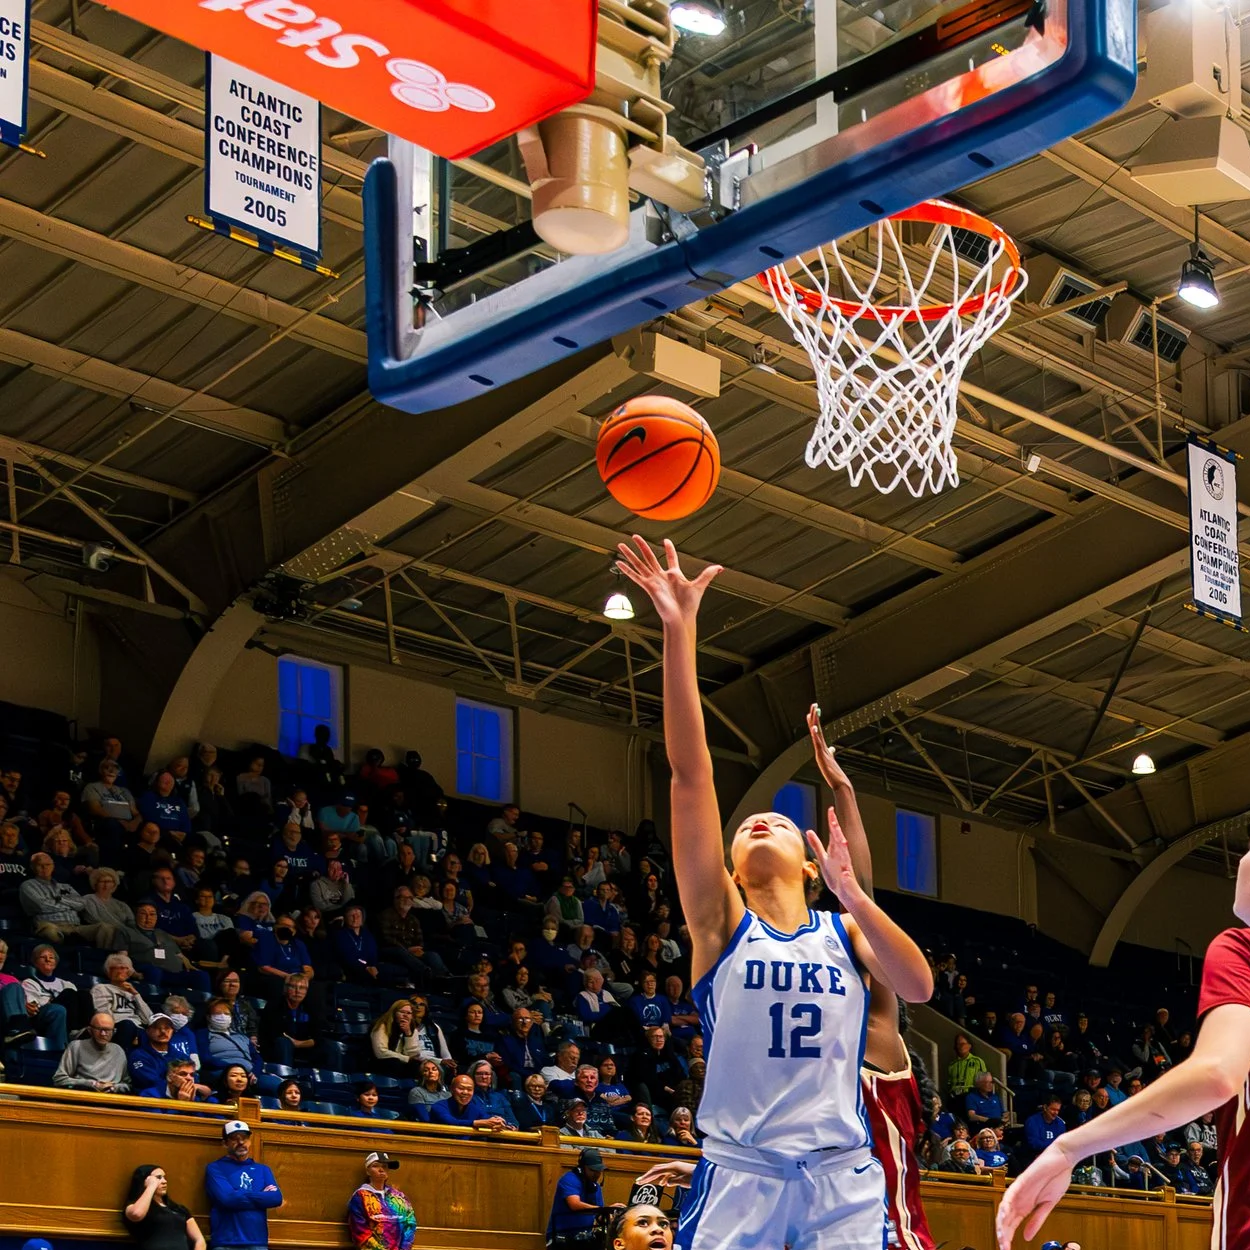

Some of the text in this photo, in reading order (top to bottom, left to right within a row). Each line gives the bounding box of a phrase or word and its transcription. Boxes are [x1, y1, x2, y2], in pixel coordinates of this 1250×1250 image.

[228, 79, 303, 123] ATLANTIC
[240, 105, 291, 139] COAST
[213, 115, 318, 172] CONFERENCE
[217, 139, 313, 191] CHAMPIONS
[234, 170, 297, 203] TOURNAMENT
[244, 195, 288, 227] 2005
[1199, 508, 1231, 533] ATLANTIC
[1204, 525, 1227, 544] COAST
[1194, 534, 1239, 564] CONFERENCE
[1196, 550, 1237, 578] CHAMPIONS
[1208, 587, 1227, 606] 2006
[743, 959, 847, 997] DUKE
[768, 1002, 822, 1059] 12
